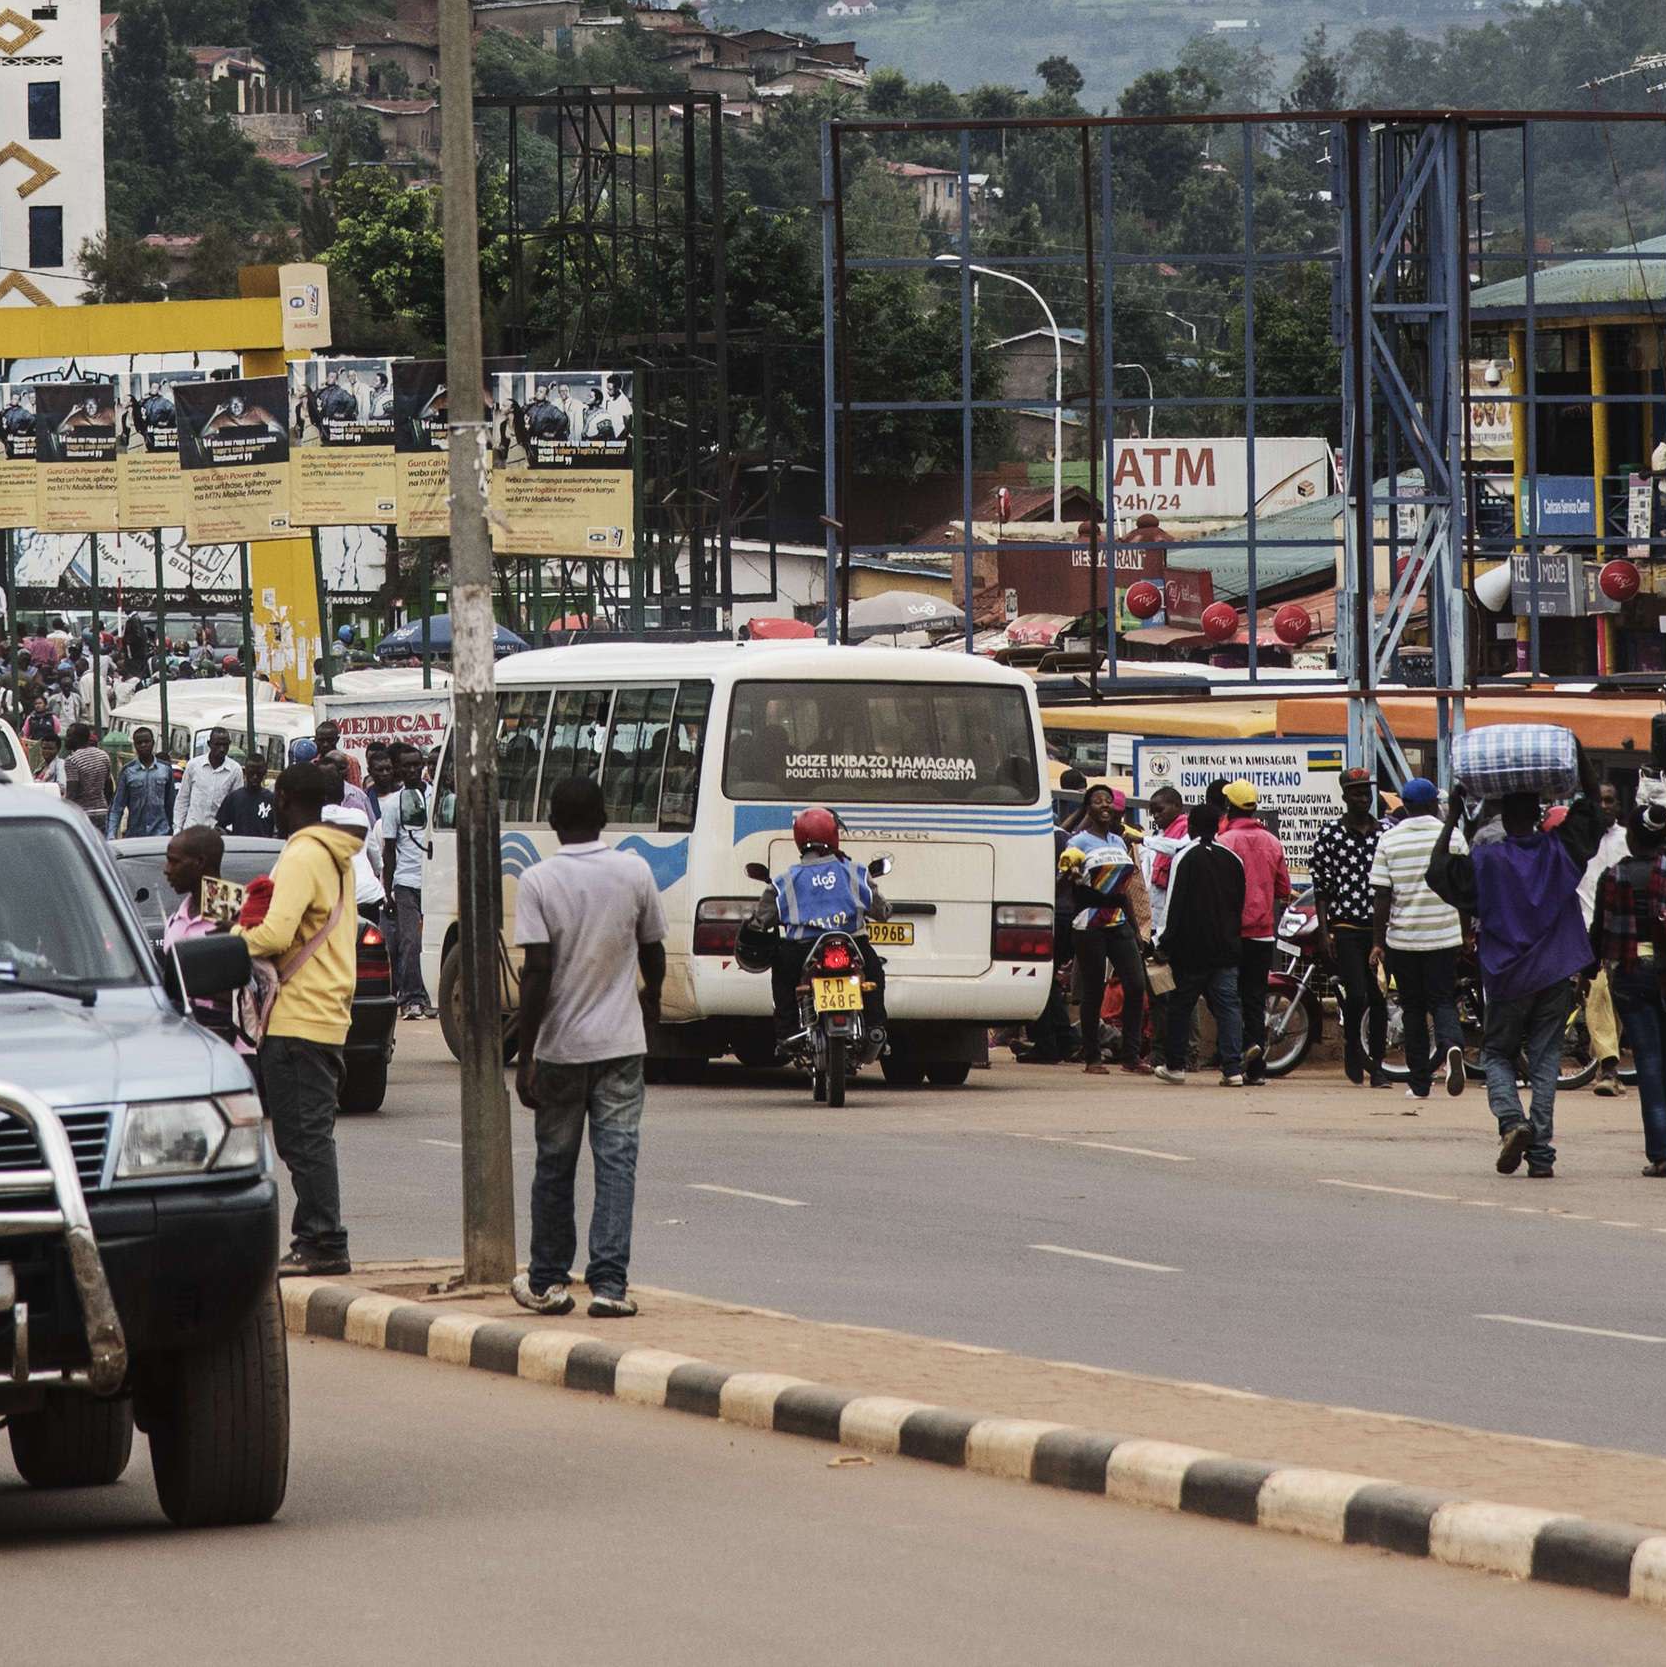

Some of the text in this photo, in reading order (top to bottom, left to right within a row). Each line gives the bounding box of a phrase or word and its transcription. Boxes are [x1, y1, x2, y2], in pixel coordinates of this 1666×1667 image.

[1113, 447, 1215, 487] ATM
[222, 489, 246, 498] Mobile
[1113, 494, 1181, 511] 24h/24
[1072, 548, 1146, 570] RESTARANT
[1513, 556, 1566, 583] TEC Mobile
[330, 713, 446, 736] MEDICAL
[785, 754, 975, 771] UGIZE IKIBAZO HAMAGARA
[1181, 754, 1297, 766] UMURENGE WA KIMISAGARA
[896, 769, 919, 780] RFTC
[1180, 772, 1215, 788] ISUKU
[1276, 794, 1332, 804] TUTAJUGUNYA
[1310, 806, 1344, 816] IMYANDA
[842, 828, 930, 841] OASTER
[811, 871, 837, 890] tigo
